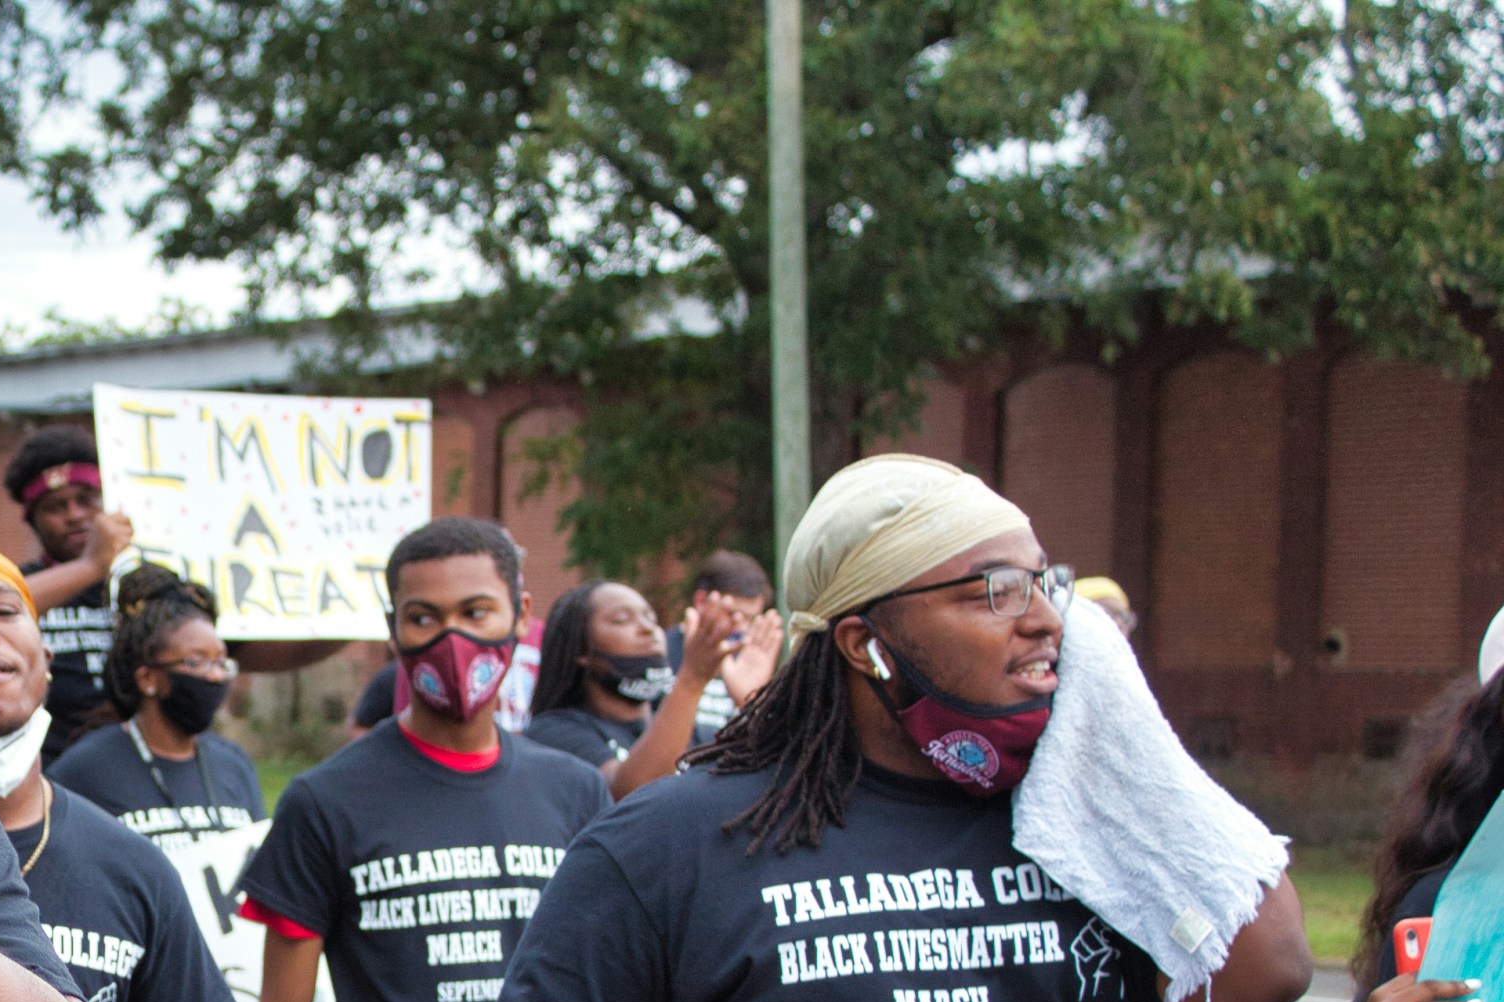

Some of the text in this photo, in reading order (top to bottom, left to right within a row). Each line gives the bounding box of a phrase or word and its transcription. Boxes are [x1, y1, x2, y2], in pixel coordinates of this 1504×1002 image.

[120, 402, 430, 493] I'M NOT
[227, 494, 287, 556] A
[350, 846, 501, 896] TALLADEGA
[359, 896, 416, 930] BLACK
[418, 890, 472, 925] LIVES
[762, 868, 984, 927] TALLADEGA
[426, 930, 503, 966] MARCH
[778, 933, 873, 985] BLACK
